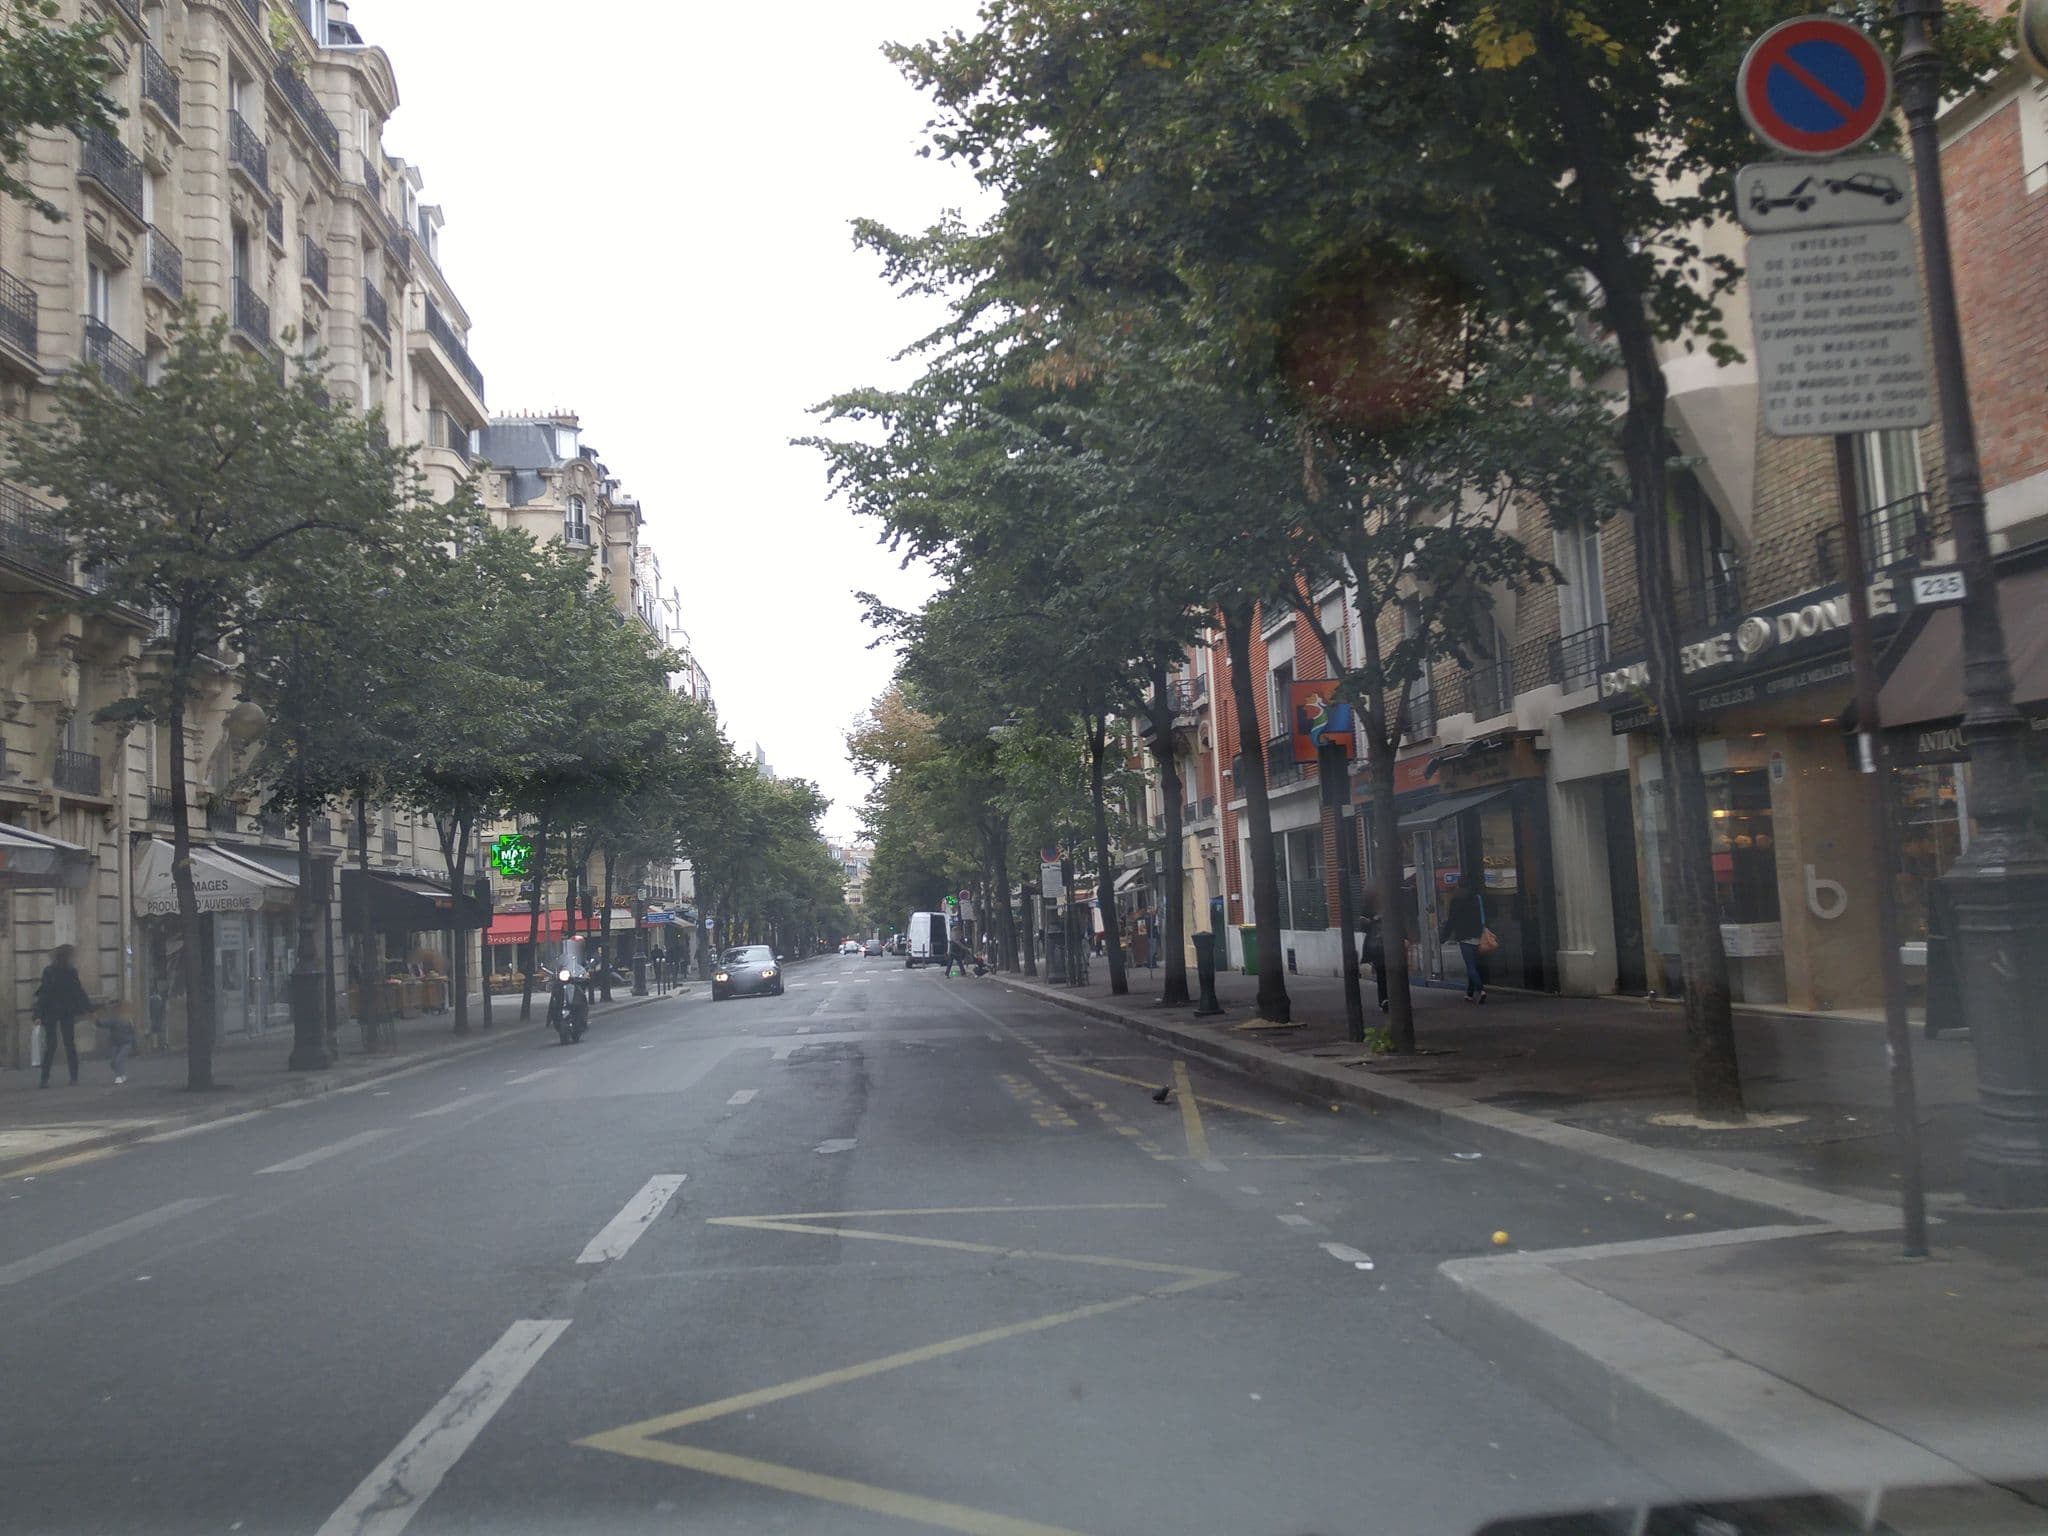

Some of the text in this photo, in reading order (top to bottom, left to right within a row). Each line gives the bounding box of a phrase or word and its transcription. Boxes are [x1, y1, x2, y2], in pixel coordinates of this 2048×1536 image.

[1791, 235, 1867, 250] INTERDIT
[1921, 577, 1960, 596] 235
[1918, 726, 1968, 753] ANTIQU
[171, 878, 230, 894] FMAGES
